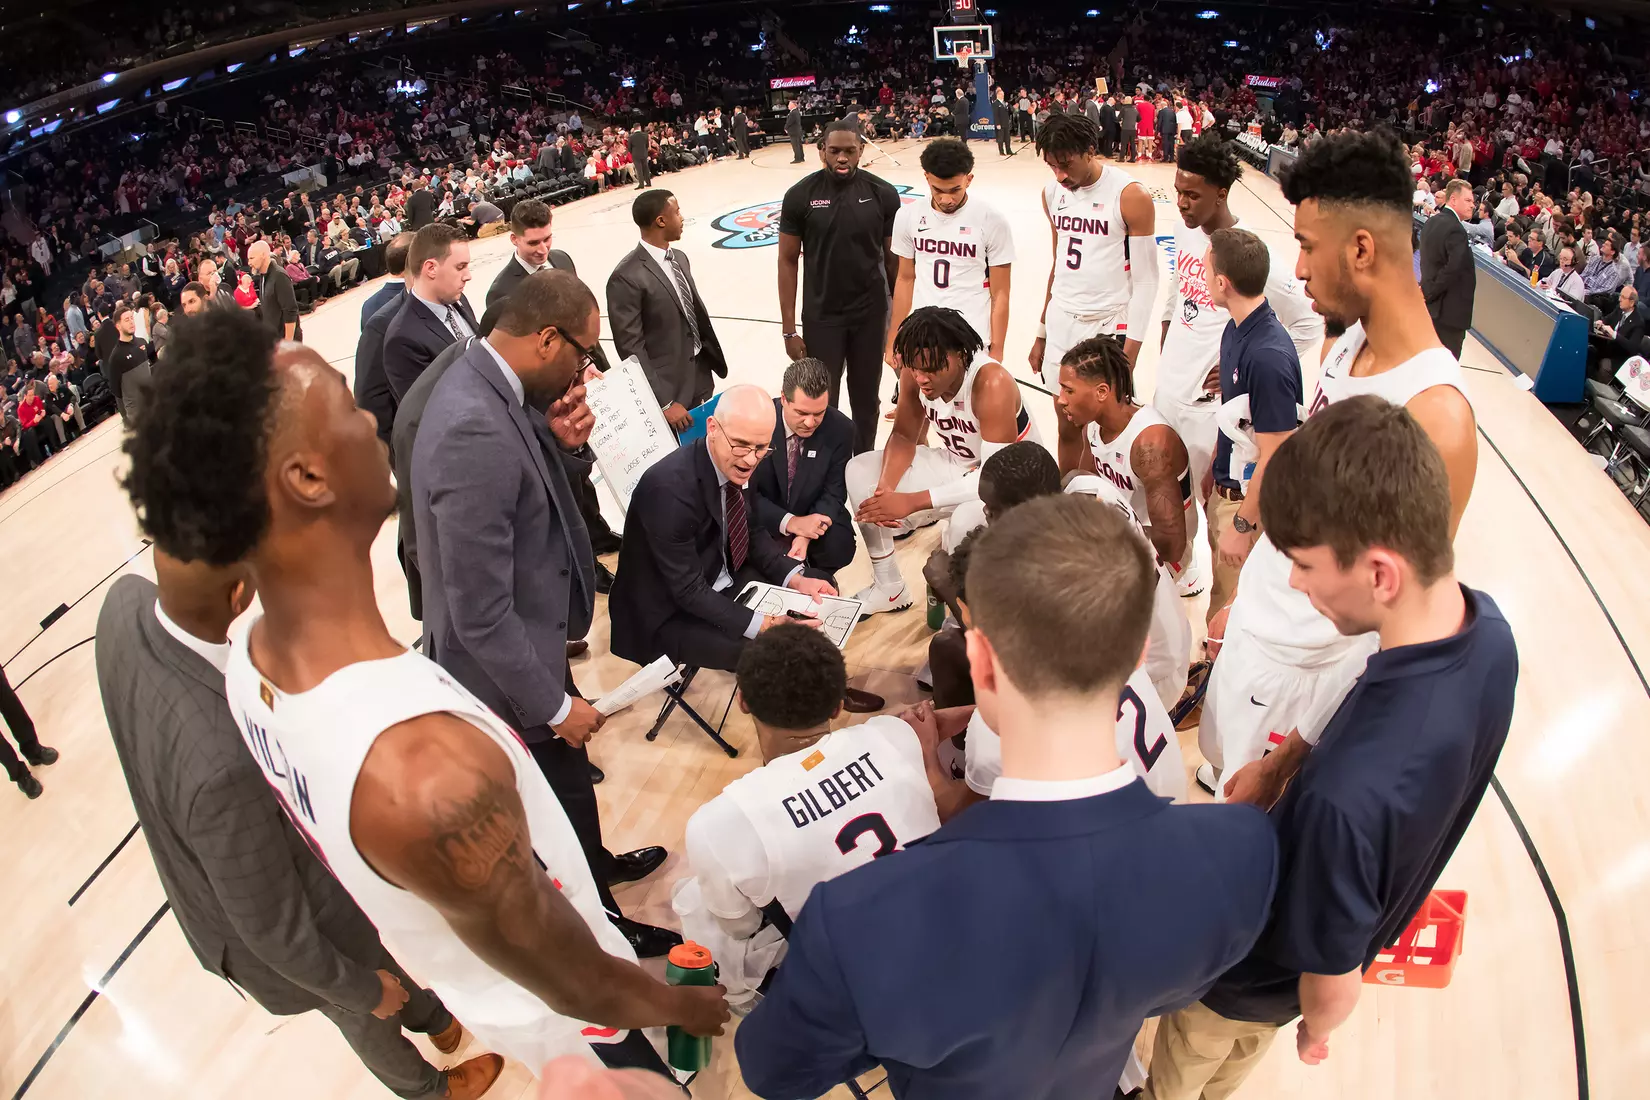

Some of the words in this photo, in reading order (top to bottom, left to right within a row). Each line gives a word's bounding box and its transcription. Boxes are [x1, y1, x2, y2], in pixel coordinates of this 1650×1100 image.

[955, 0, 971, 10] 30
[1053, 214, 1109, 236] UCONN
[912, 236, 977, 258] UCONN
[1065, 236, 1083, 271] 5
[933, 258, 951, 289] 0
[1178, 276, 1217, 312] ANCER
[623, 456, 641, 474] LOOSE
[641, 442, 660, 459] BALLS
[1092, 455, 1135, 491] CONN
[781, 751, 885, 829] GILBERT
